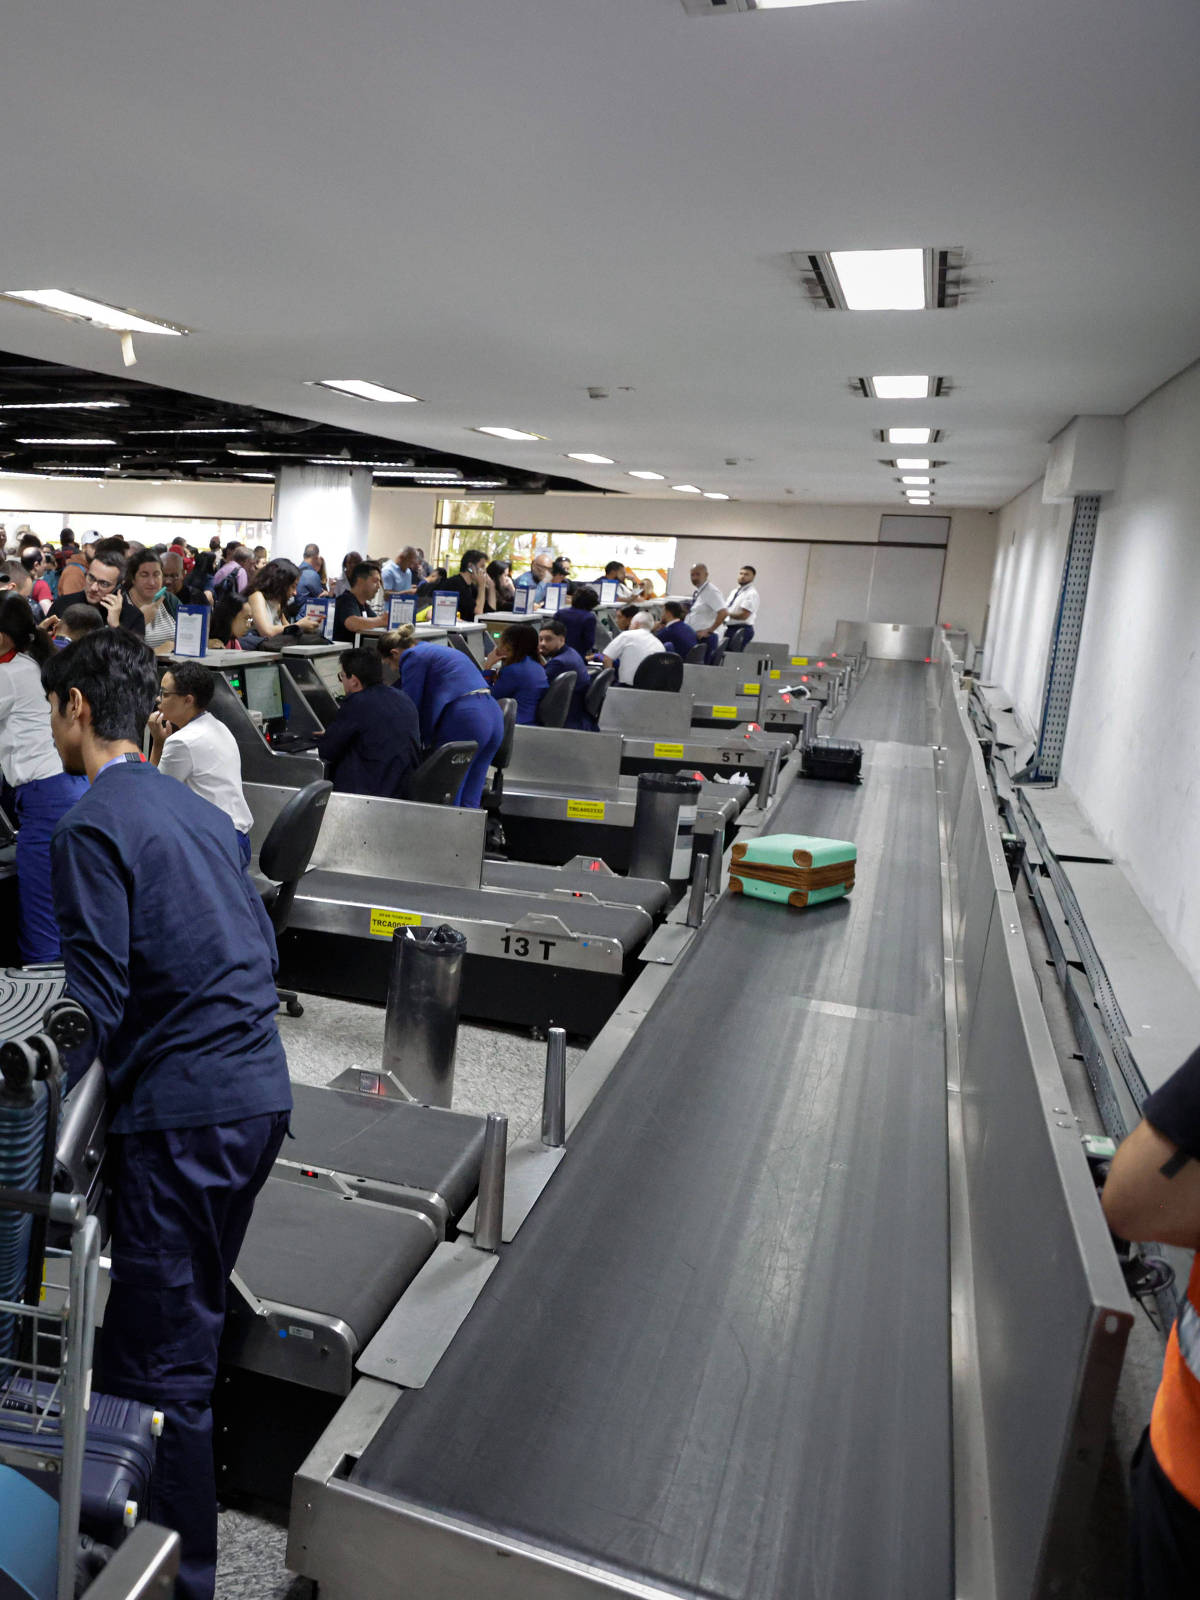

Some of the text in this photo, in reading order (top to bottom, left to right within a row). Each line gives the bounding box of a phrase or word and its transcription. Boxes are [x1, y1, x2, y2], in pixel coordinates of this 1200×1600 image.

[722, 752, 744, 763] 5 T
[500, 935, 557, 961] 13 T
